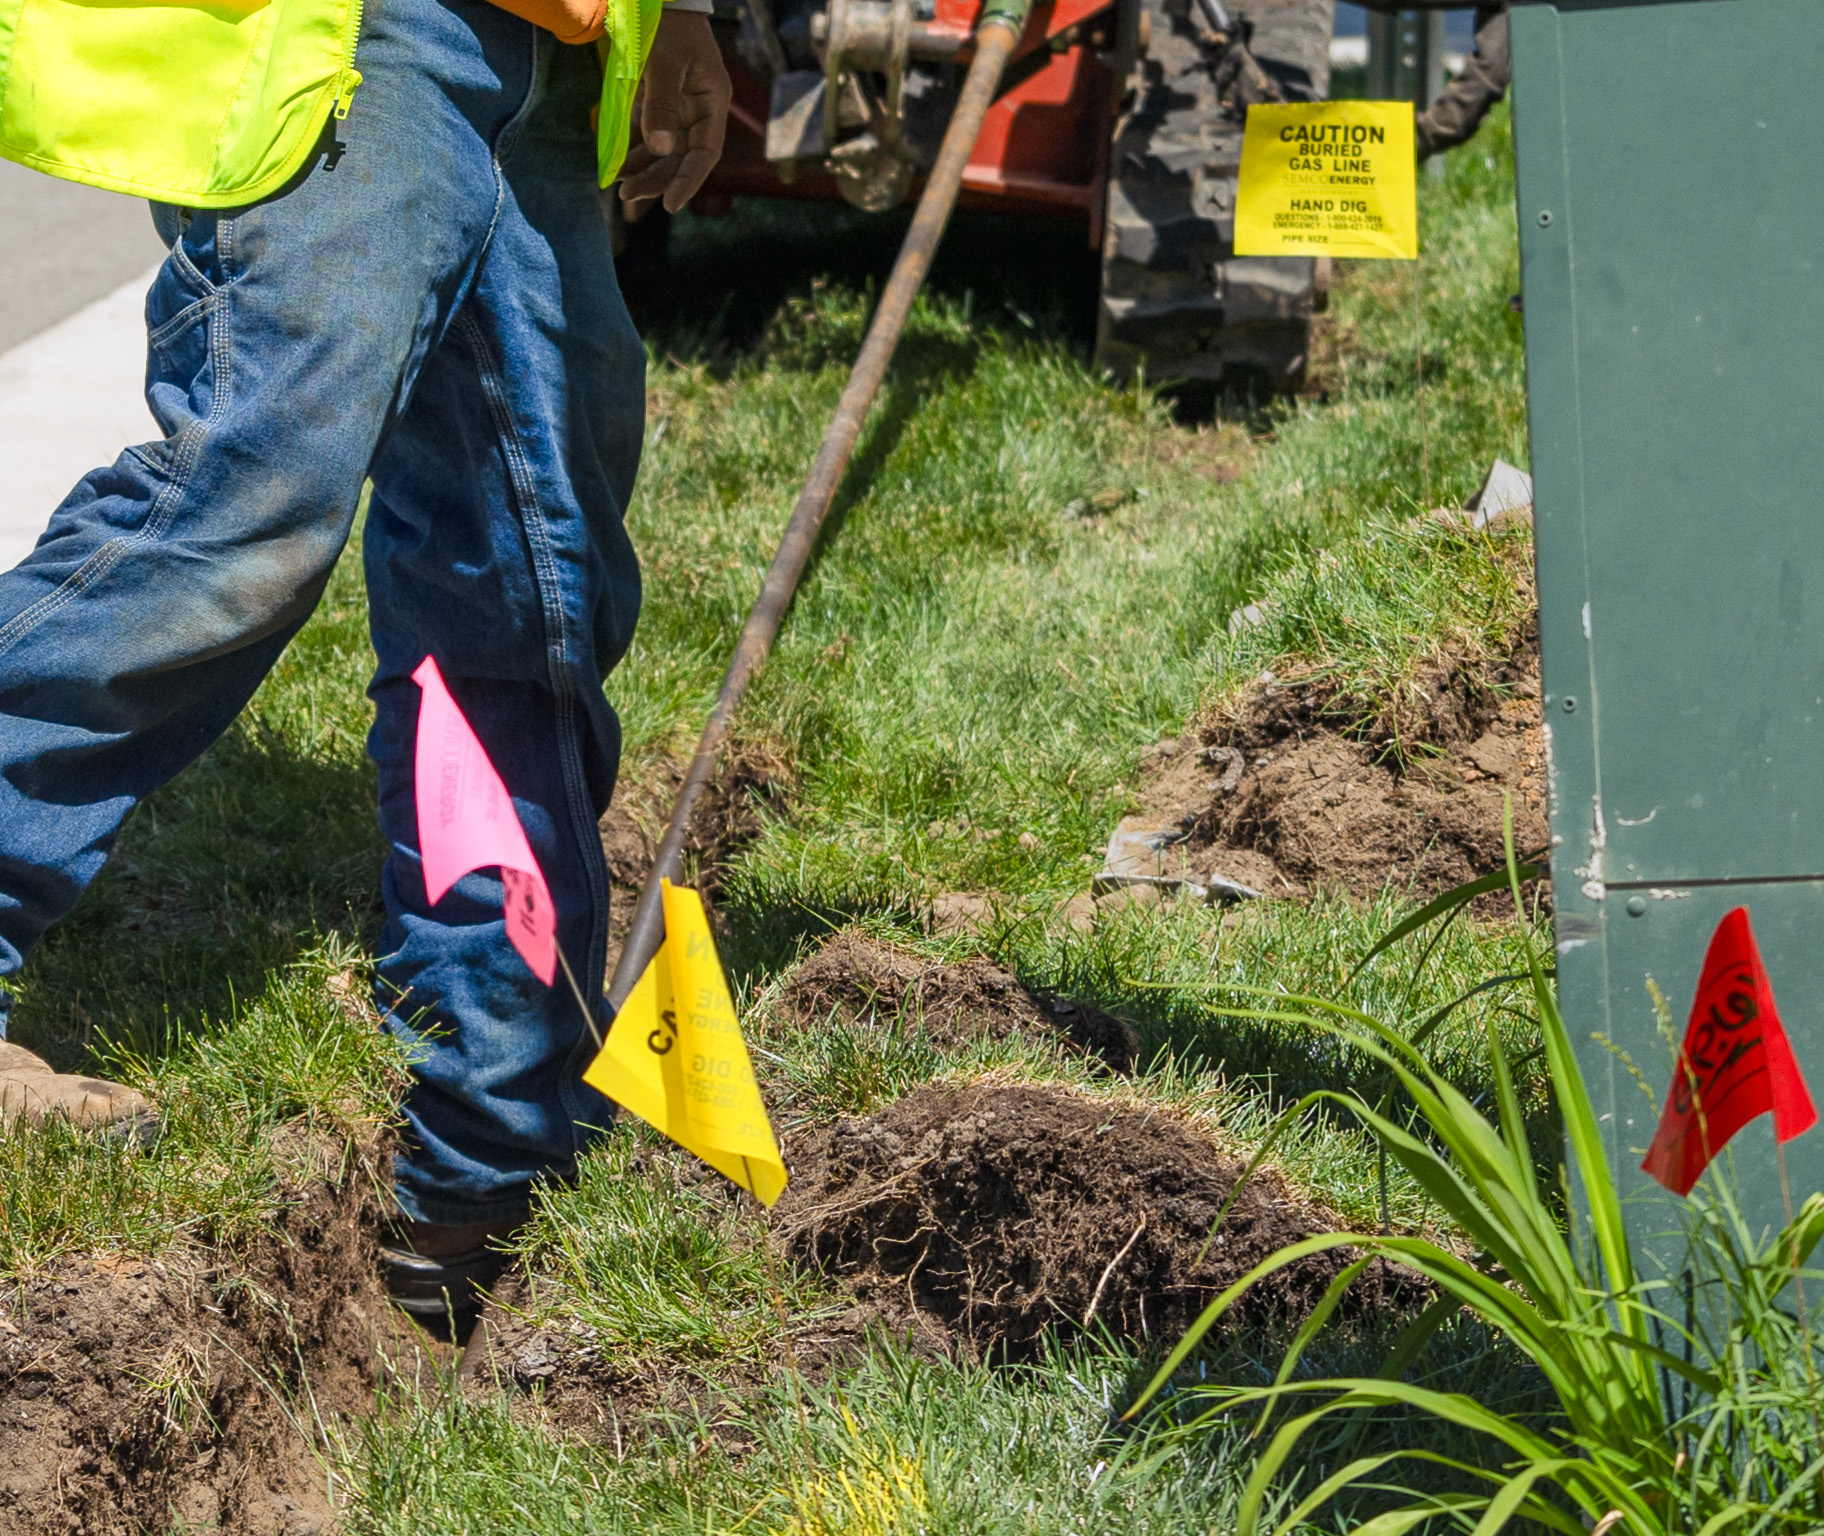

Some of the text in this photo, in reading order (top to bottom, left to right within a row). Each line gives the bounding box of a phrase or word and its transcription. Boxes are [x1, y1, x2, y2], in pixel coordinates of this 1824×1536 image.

[1279, 125, 1385, 144] CAUTION
[1299, 143, 1363, 157] BURIED
[1289, 157, 1372, 173] GAS LINE
[1290, 199, 1368, 213] HAND DIG
[1274, 212, 1319, 221] QUESTIONS
[1273, 221, 1321, 230] EMERGENCY
[1282, 234, 1329, 244] PIPE SIZE
